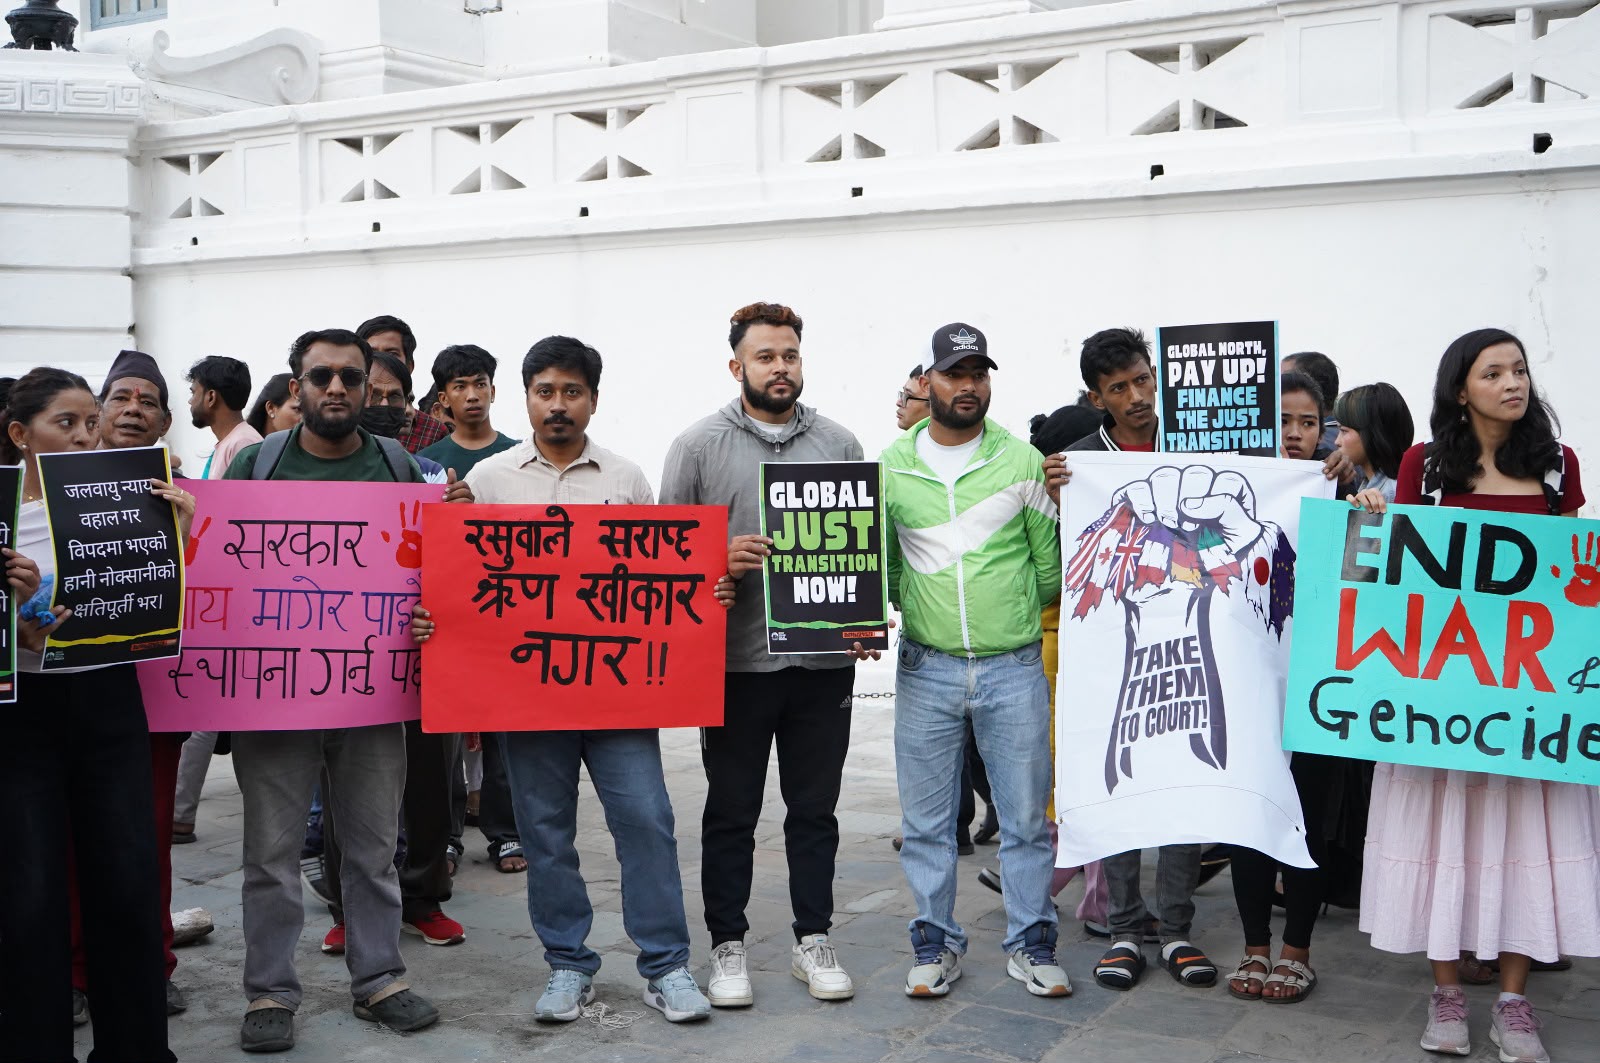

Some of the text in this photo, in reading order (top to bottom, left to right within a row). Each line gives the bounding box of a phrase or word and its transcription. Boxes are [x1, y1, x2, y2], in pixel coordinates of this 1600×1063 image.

[1168, 341, 1266, 358] GLOBAL NORTH,
[1168, 358, 1266, 387] PAY UP!
[1178, 386, 1257, 408] FINANCE
[1176, 408, 1260, 430] THE JUST
[1166, 429, 1273, 451] TRANSITION
[64, 482, 121, 501] जलवायु
[770, 481, 874, 508] GLOBAL
[121, 508, 140, 524] गर
[772, 511, 874, 550] JUST
[68, 530, 168, 560] विपदमा भएको
[224, 520, 368, 569] सरकार
[464, 506, 574, 571] रसुवाले
[1340, 509, 1538, 595] END
[63, 559, 177, 594] हानी नोक्सानीको
[772, 554, 878, 573] TRANSITION
[74, 593, 135, 619] क्षतिपूर्ती
[252, 576, 353, 631] मागेर
[471, 563, 705, 625] ऋण स्वीकार
[793, 576, 857, 604] NOW!
[1134, 635, 1201, 676] TAKE
[1335, 588, 1600, 694] WAR &
[168, 647, 300, 699] स्थापना
[310, 635, 377, 694] गर्नु
[1125, 666, 1206, 711] THEM
[1120, 699, 1208, 745] TO COURT!
[1308, 676, 1600, 763] Genocide
